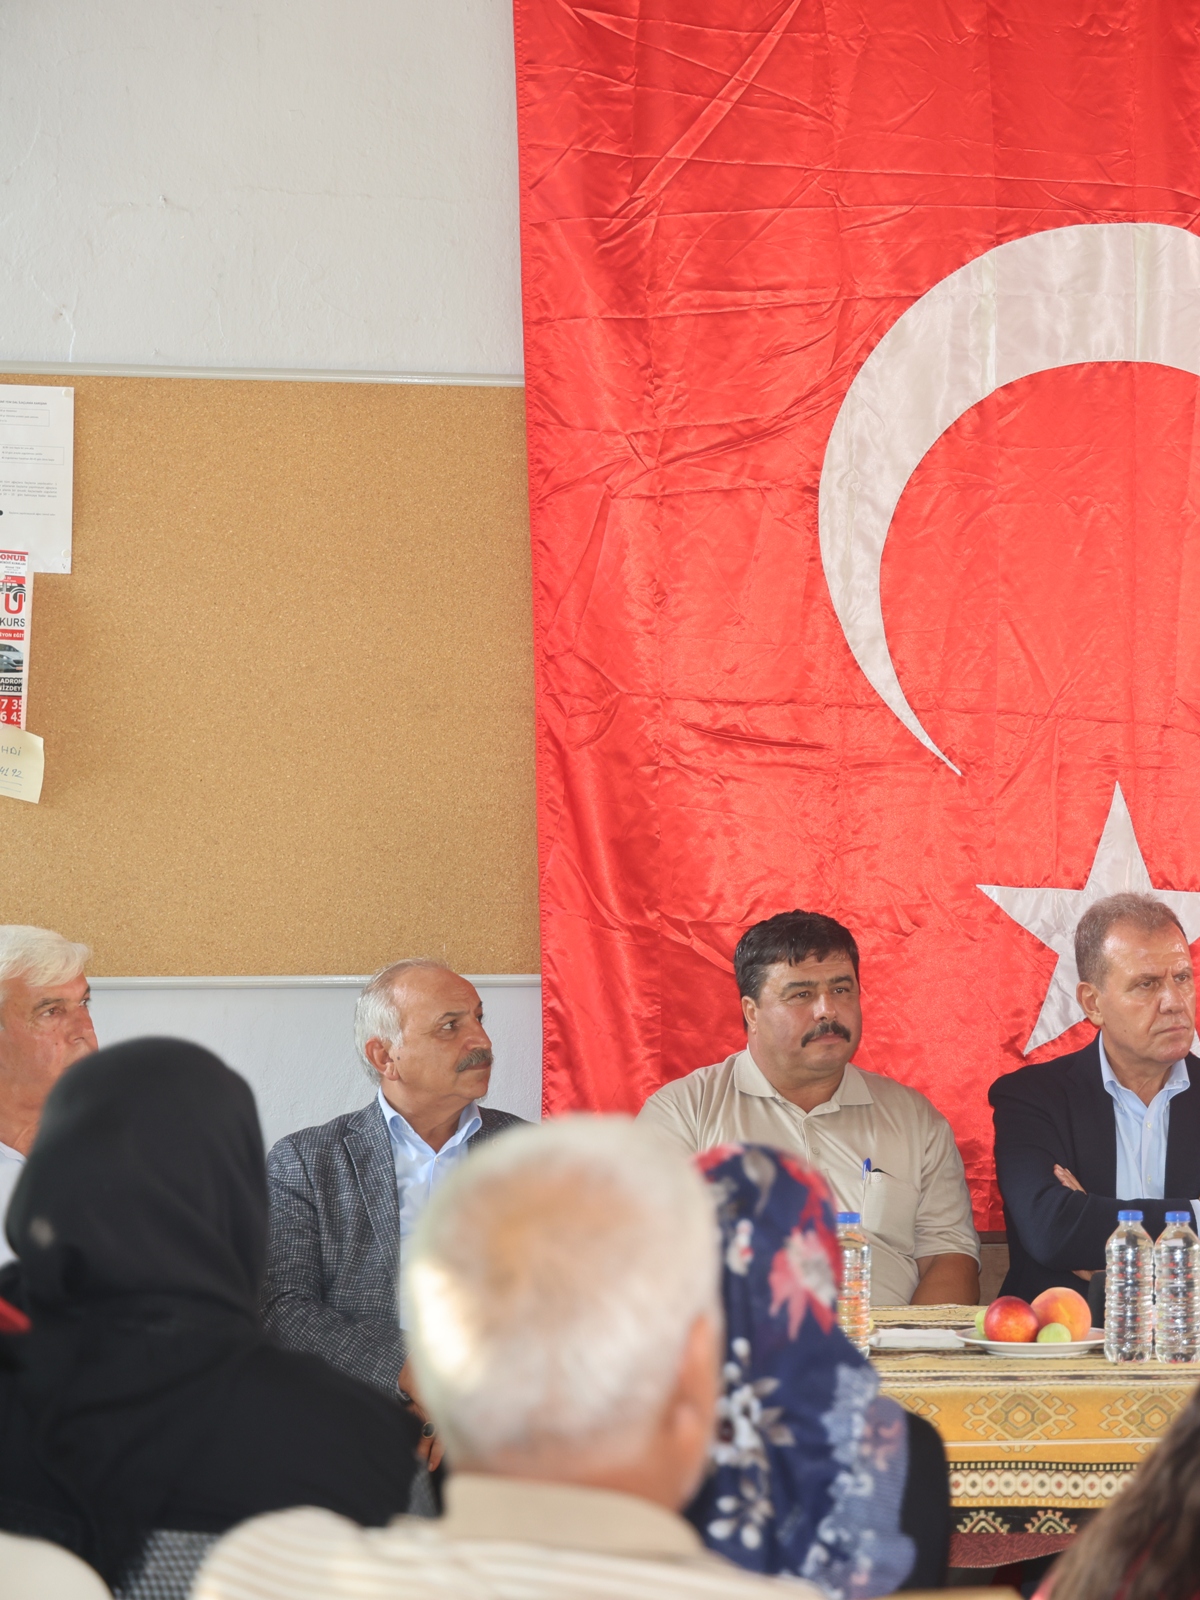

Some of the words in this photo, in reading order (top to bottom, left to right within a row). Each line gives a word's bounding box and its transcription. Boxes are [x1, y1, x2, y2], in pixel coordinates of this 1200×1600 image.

[0, 553, 26, 562] ONUR
[1, 699, 8, 709] 7
[1, 711, 8, 722] 6
